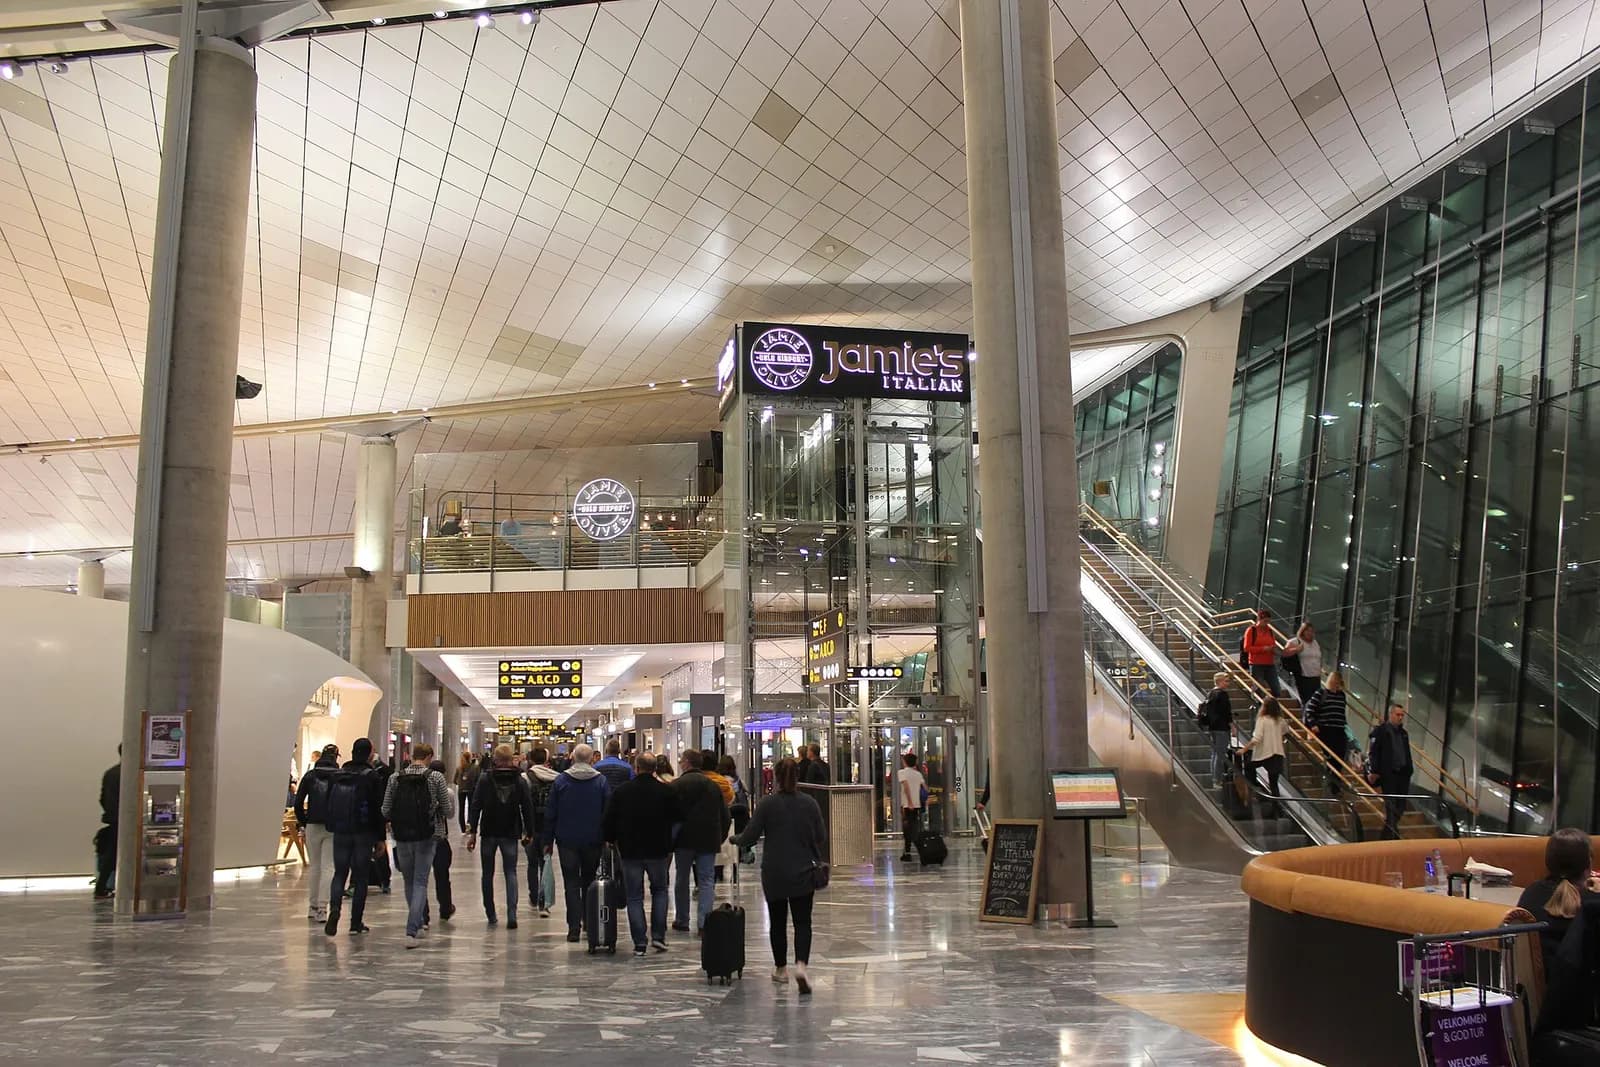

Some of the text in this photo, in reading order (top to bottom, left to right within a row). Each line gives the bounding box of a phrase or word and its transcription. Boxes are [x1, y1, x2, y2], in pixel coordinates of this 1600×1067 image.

[760, 331, 804, 350] JAMIE
[820, 341, 964, 384] Jamie's
[758, 367, 807, 387] OLIVER
[883, 376, 964, 393] ITALIAN
[583, 480, 626, 500] JAMIE
[580, 517, 628, 536] OLIVER
[1438, 1012, 1487, 1030] VELKOMMEN
[1443, 1027, 1485, 1043] & GOD TUR
[1447, 1054, 1489, 1067] WELCOME
